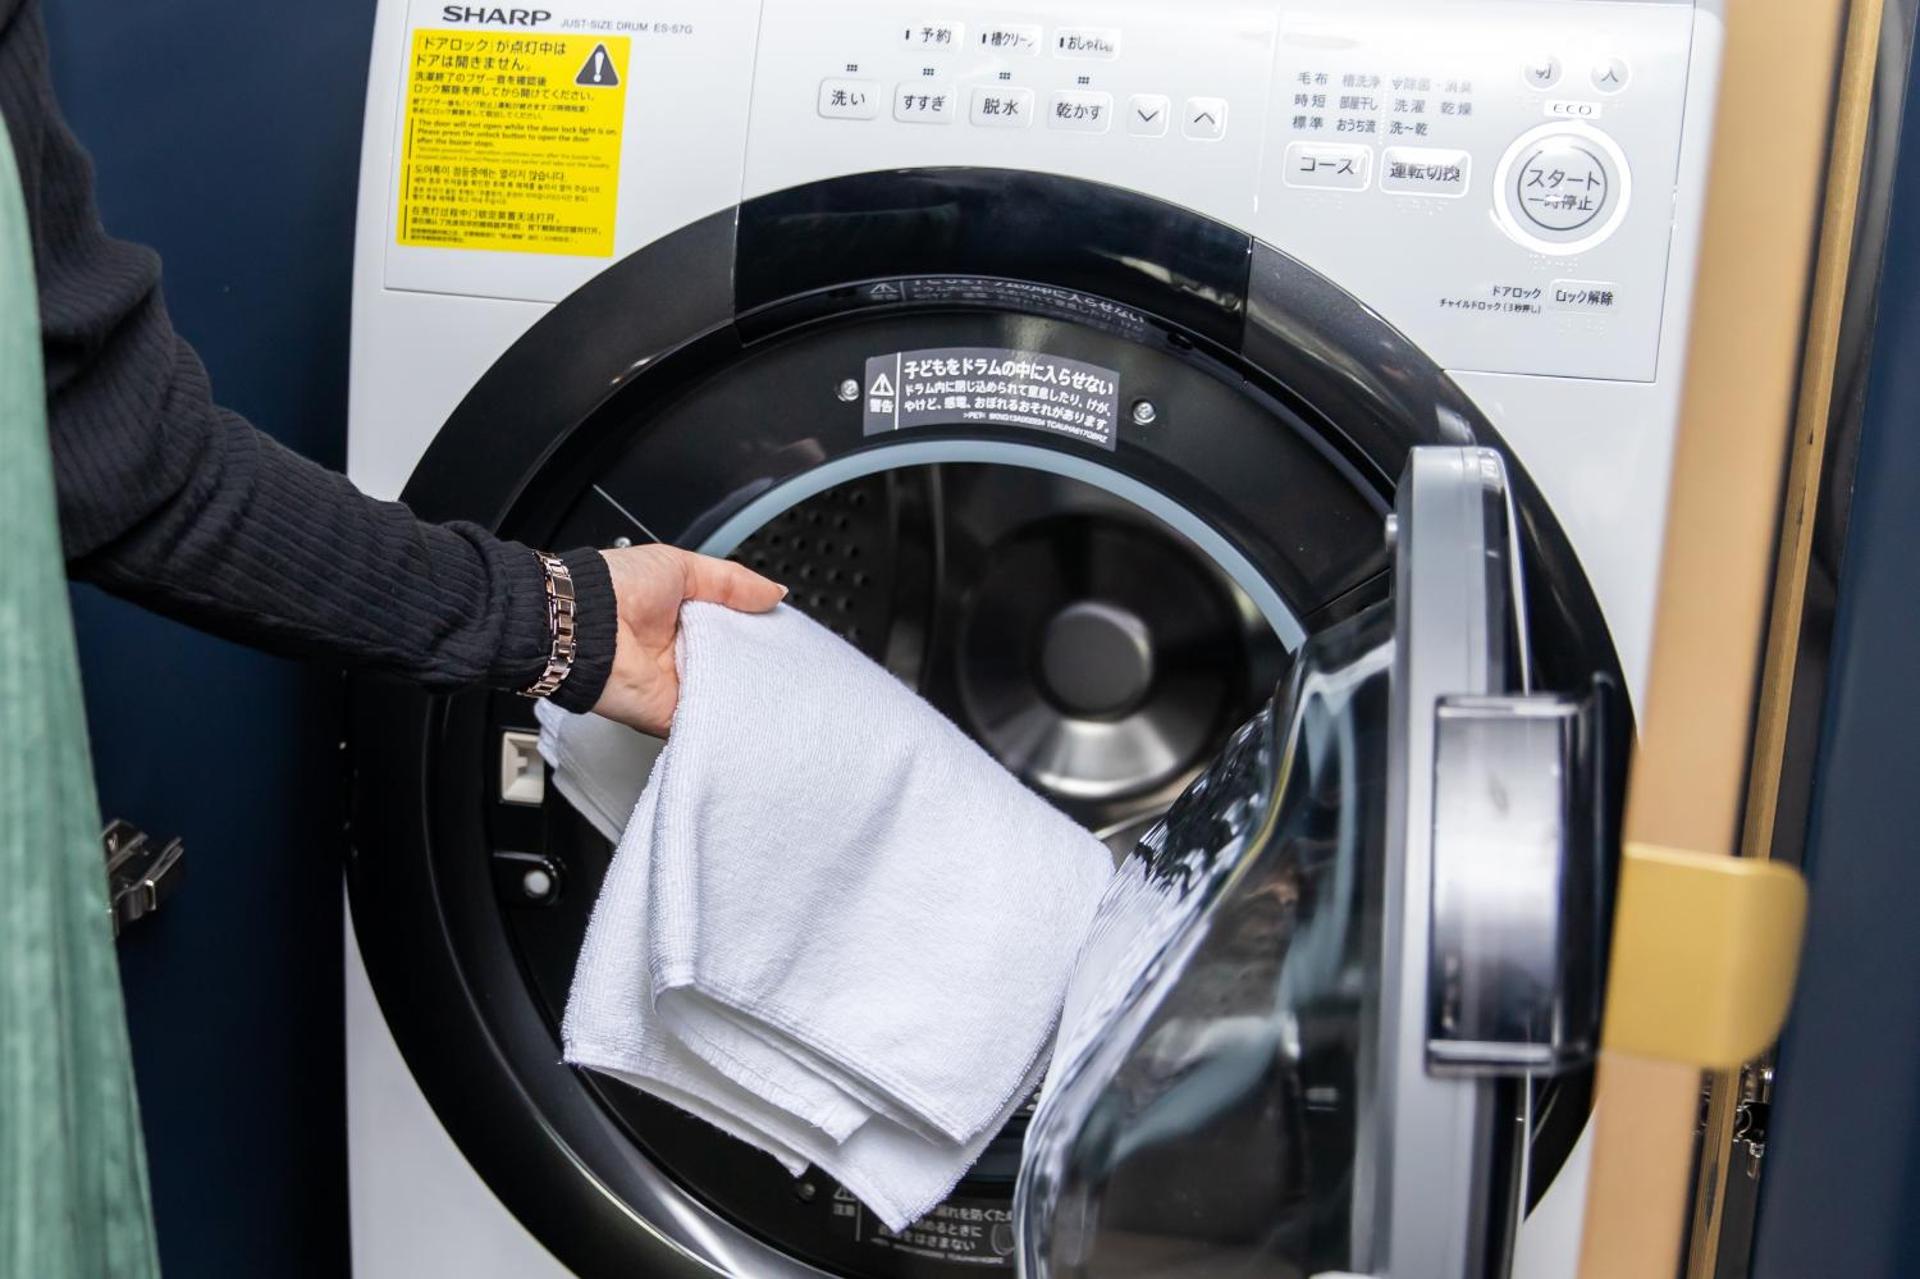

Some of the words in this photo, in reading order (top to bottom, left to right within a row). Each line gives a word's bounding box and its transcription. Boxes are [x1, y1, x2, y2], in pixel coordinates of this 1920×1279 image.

[442, 5, 552, 26] SHARP
[617, 22, 648, 32] DRUM
[653, 23, 693, 34] ES-S7G
[921, 28, 951, 44] 予約
[991, 31, 1034, 47] 槽クリーン
[1298, 71, 1328, 86] 毛布
[831, 89, 865, 106] 洗い
[904, 95, 946, 112] すすぎ
[1294, 94, 1326, 109] 時短
[1340, 95, 1379, 111] 部屋干し
[983, 98, 1018, 115] 脱水
[1056, 102, 1103, 120] 乾かす
[1394, 99, 1426, 113] 洗濯
[1441, 101, 1472, 116] 乾燥
[1292, 115, 1323, 130] 標準
[1336, 118, 1376, 133] おうち流
[1301, 157, 1354, 175] コース
[1389, 162, 1460, 182] 運転切換
[1527, 169, 1600, 191] スタート
[1493, 285, 1542, 299] ドアロック
[1555, 289, 1614, 307] ロック解除
[904, 357, 1113, 395] 子どもをドラムの中に入らせない
